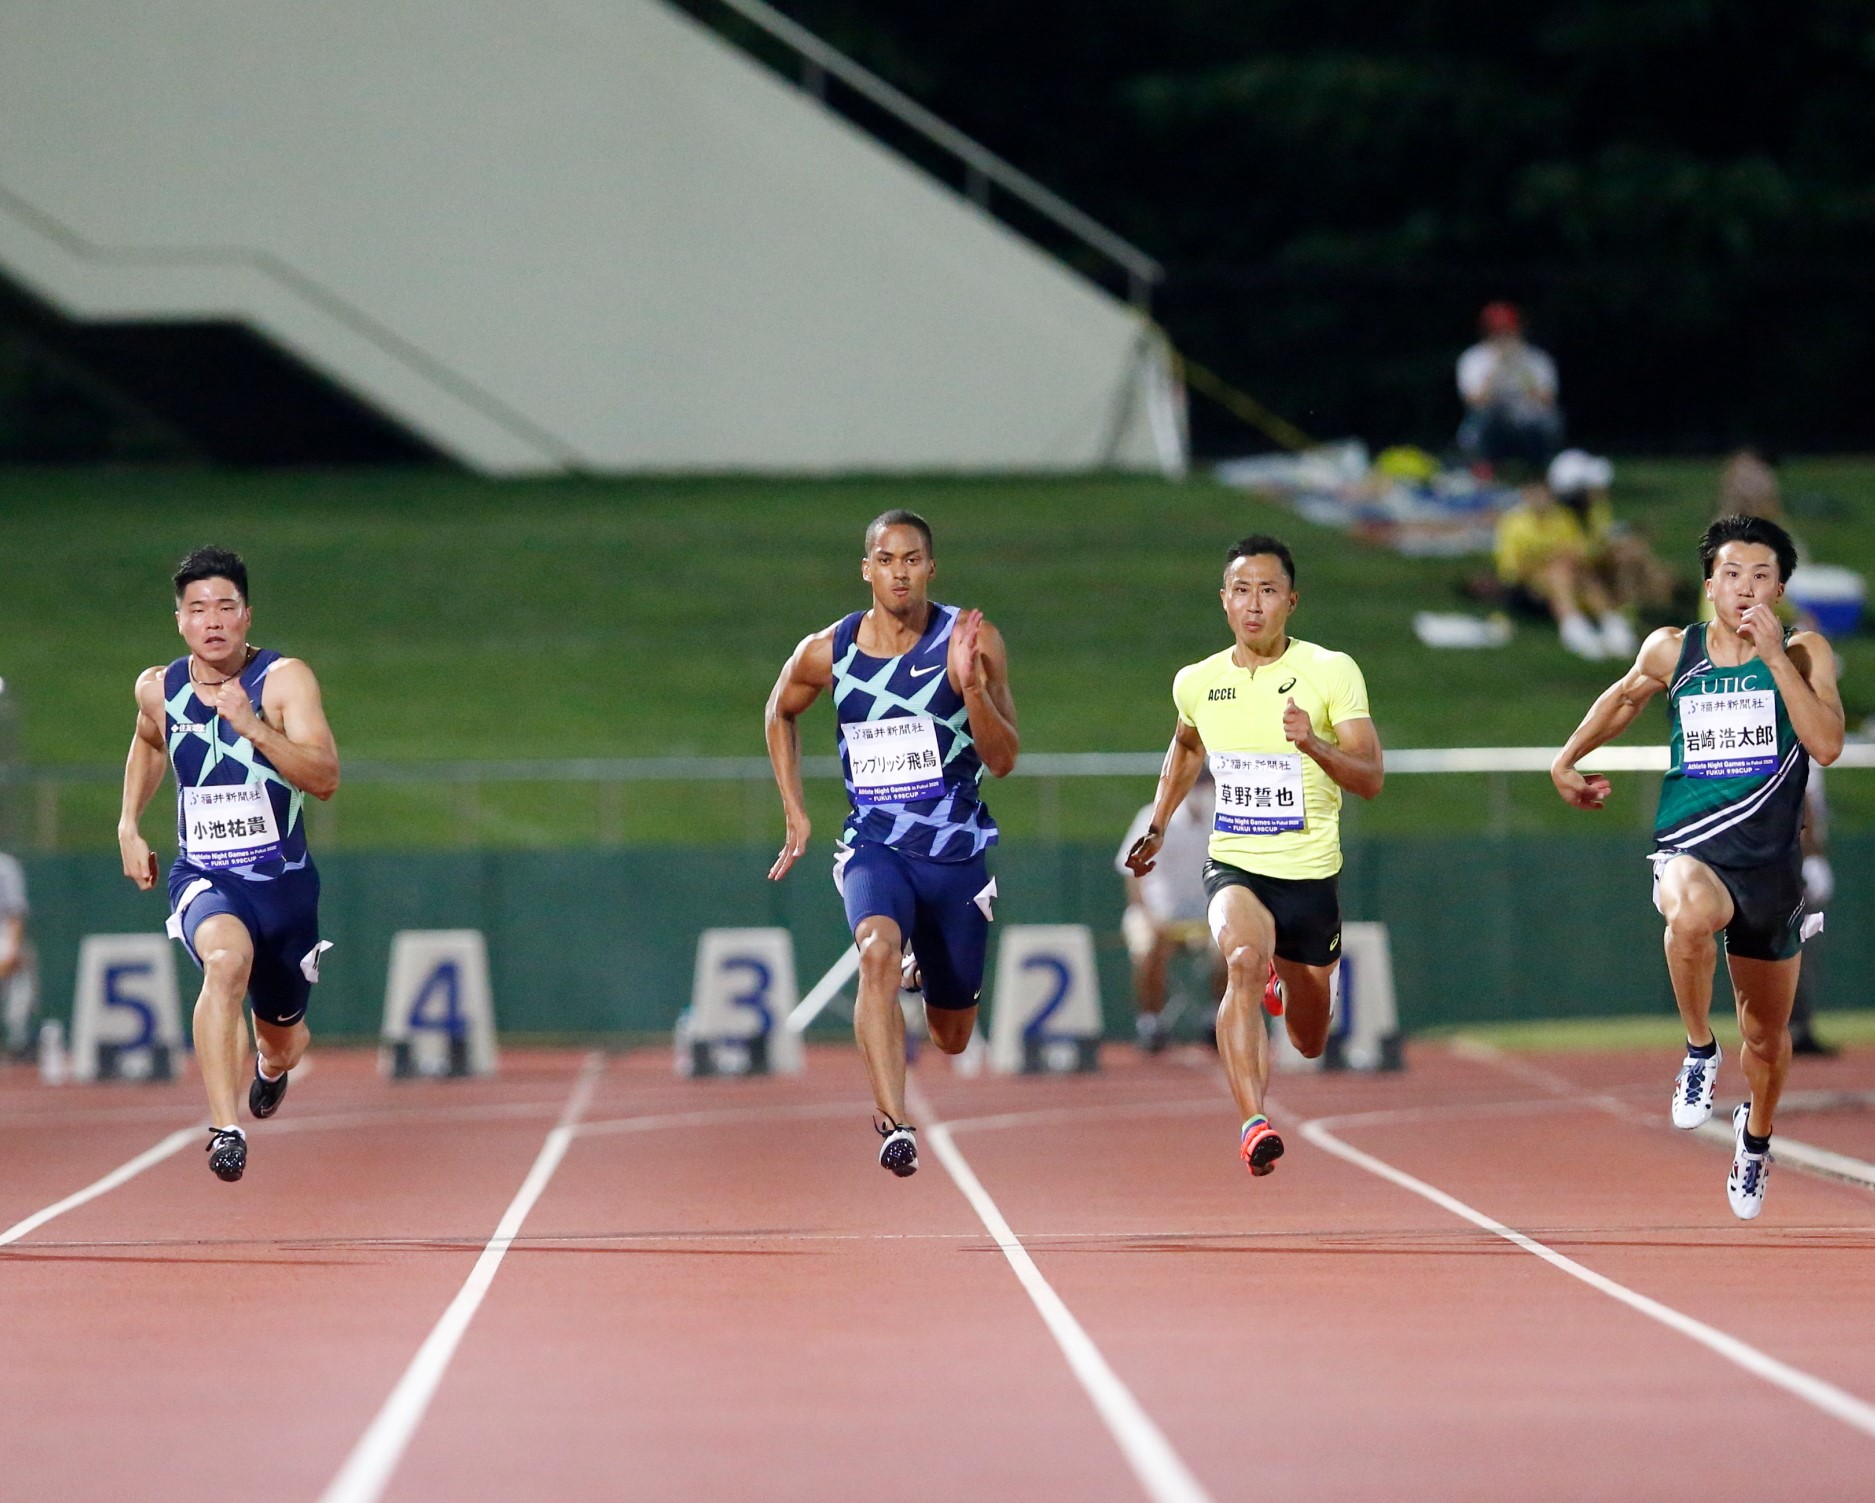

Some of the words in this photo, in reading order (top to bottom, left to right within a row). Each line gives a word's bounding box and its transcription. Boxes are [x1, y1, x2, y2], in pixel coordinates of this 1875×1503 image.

[1208, 687, 1237, 701] ACCEL
[1701, 674, 1757, 694] UTIC
[1686, 725, 1774, 752] 岩崎浩太郎
[852, 749, 937, 774] ケンブリッジ飛鳥
[1707, 761, 1723, 769] Night
[1724, 760, 1746, 768] Games
[193, 816, 268, 840] 小池祐貴
[1234, 818, 1249, 826] Night
[1250, 818, 1271, 826] Games
[210, 859, 229, 867] FUKUI
[212, 852, 227, 861] Night
[104, 961, 157, 1053] 5
[409, 960, 467, 1044] 4
[720, 956, 774, 1047] 3
[1021, 954, 1074, 1044] 2
